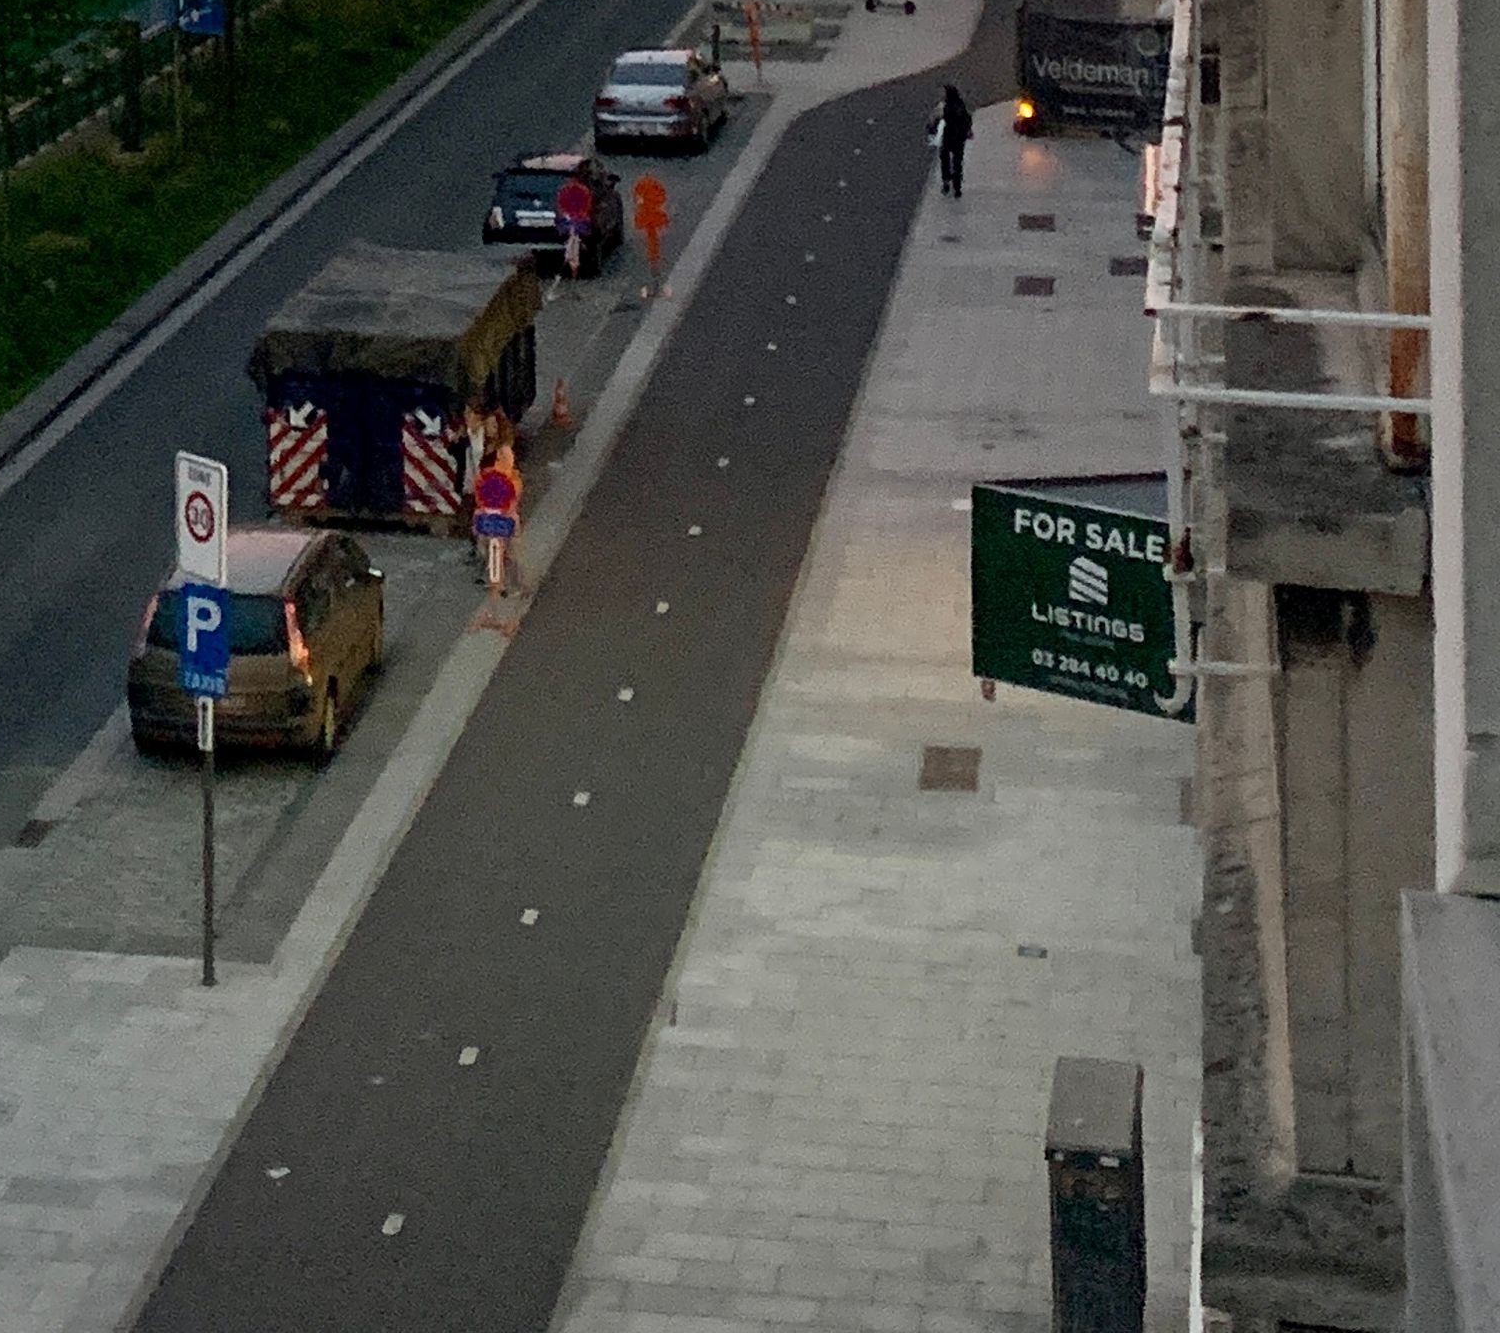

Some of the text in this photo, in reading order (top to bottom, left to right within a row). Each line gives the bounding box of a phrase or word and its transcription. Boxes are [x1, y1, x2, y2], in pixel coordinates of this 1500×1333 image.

[1032, 53, 1149, 88] Veldeman
[189, 505, 211, 530] 30
[1014, 508, 1165, 563] FOR SALE
[186, 596, 222, 652] P
[1031, 648, 1054, 669] 03
[1095, 664, 1120, 682] 40
[1124, 670, 1149, 689] 40
